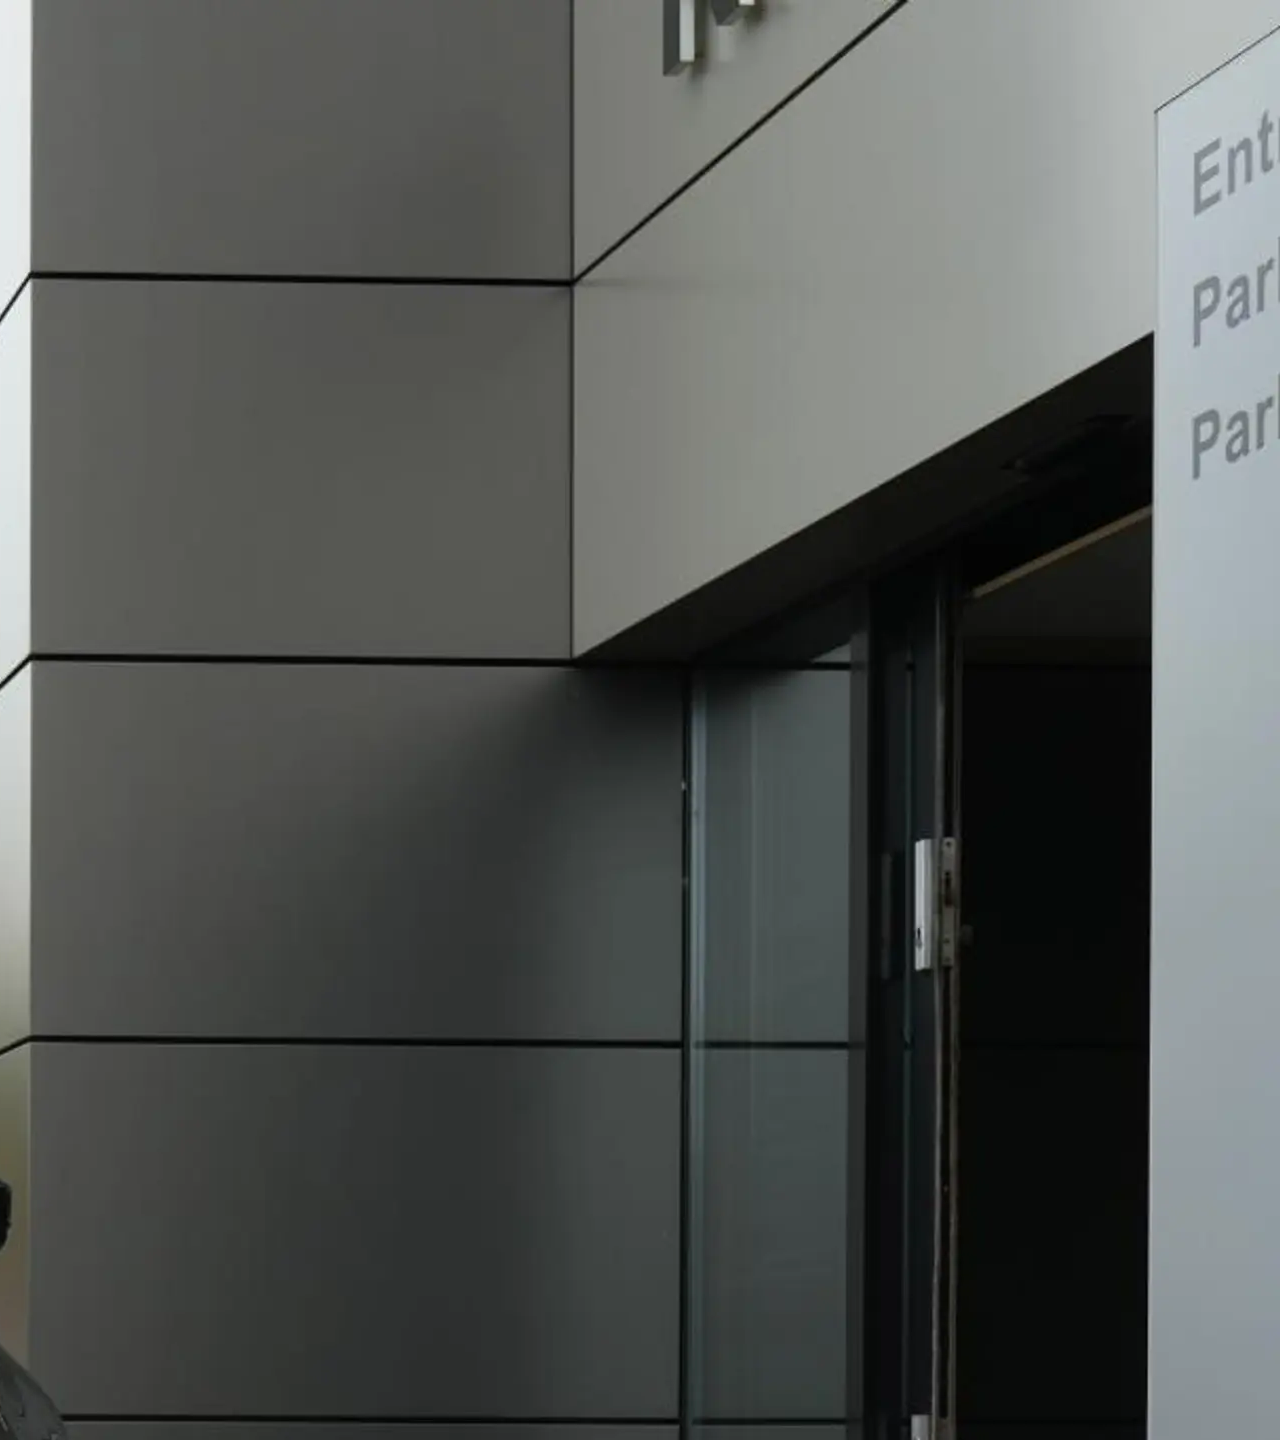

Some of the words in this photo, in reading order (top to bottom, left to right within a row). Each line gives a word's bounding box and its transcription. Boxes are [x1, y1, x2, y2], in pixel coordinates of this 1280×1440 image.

[1193, 110, 1280, 216] Ent
[1193, 237, 1280, 348] Par
[1192, 373, 1280, 480] Par
